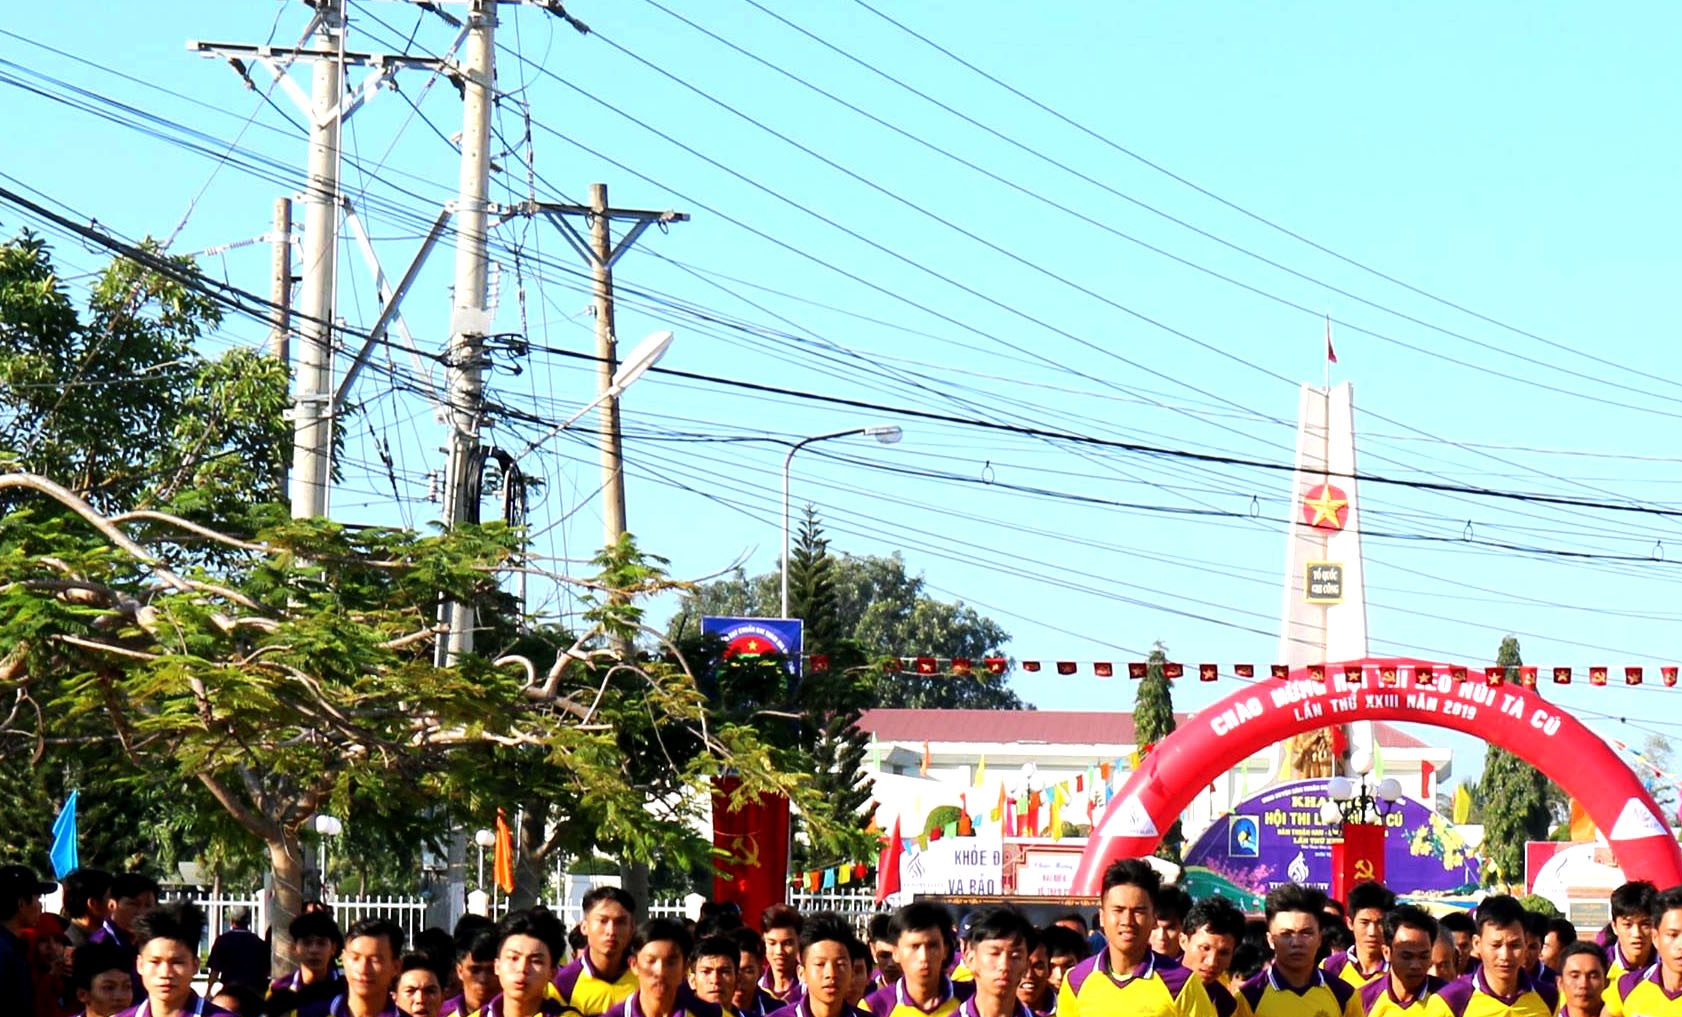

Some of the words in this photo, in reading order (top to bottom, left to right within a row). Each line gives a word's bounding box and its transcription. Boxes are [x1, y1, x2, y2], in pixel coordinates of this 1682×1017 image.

[1210, 697, 1263, 736] CHÀO
[1333, 670, 1367, 692] HI
[1459, 682, 1496, 706] NÚI
[1500, 694, 1524, 719] TÀ
[1530, 709, 1561, 736] CÚ
[1365, 694, 1399, 708] XXIII
[1407, 692, 1438, 712] NĂM
[1443, 700, 1477, 720] 2019
[1264, 809, 1287, 828] HỘI
[1289, 812, 1311, 826] THI
[1386, 810, 1404, 827] CÚ
[955, 844, 987, 866] KHỎE
